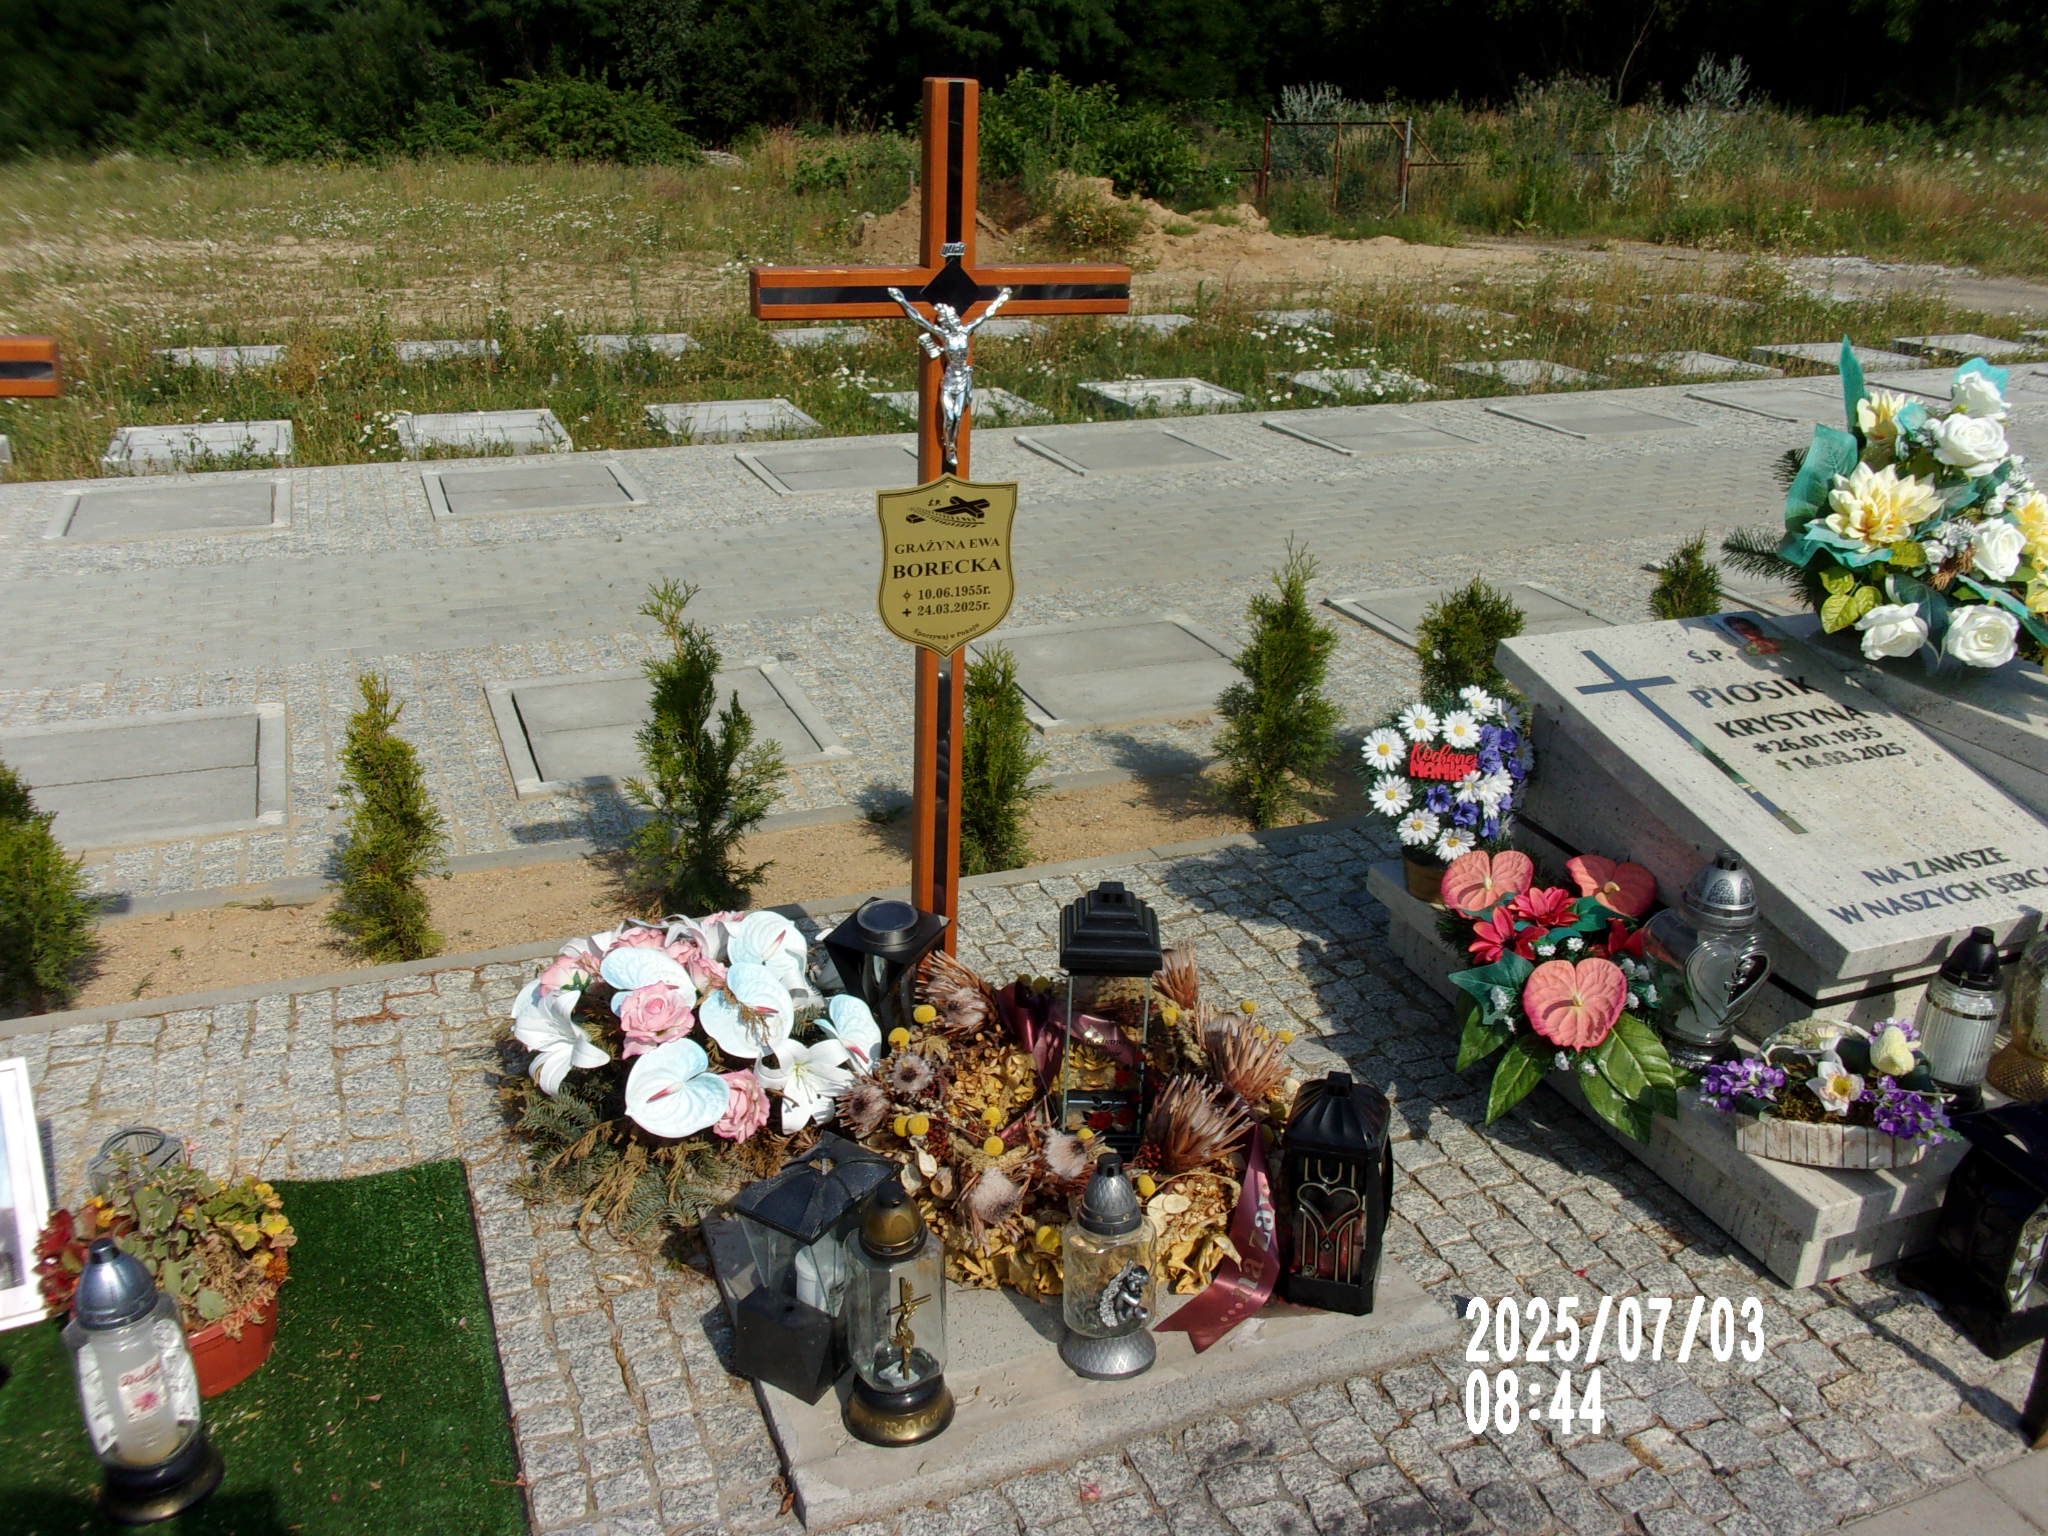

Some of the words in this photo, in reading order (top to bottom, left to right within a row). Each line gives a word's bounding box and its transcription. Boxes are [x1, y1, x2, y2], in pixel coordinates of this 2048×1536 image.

[894, 539, 966, 555] GRAŻYNA
[969, 537, 1001, 550] EWA
[892, 558, 1001, 580] BORECKA
[917, 585, 991, 601] 10.06.1955r.
[917, 601, 991, 617] 24.03.2025r.
[1687, 676, 1824, 708] PIOSIK
[1714, 704, 1870, 738] KRYSTYNA
[1861, 865, 1914, 887] NA
[1903, 846, 2012, 878] ZAWSZE
[1827, 903, 1865, 925] W
[1861, 880, 1993, 918] NASZYCH
[1985, 864, 2048, 894] SERC
